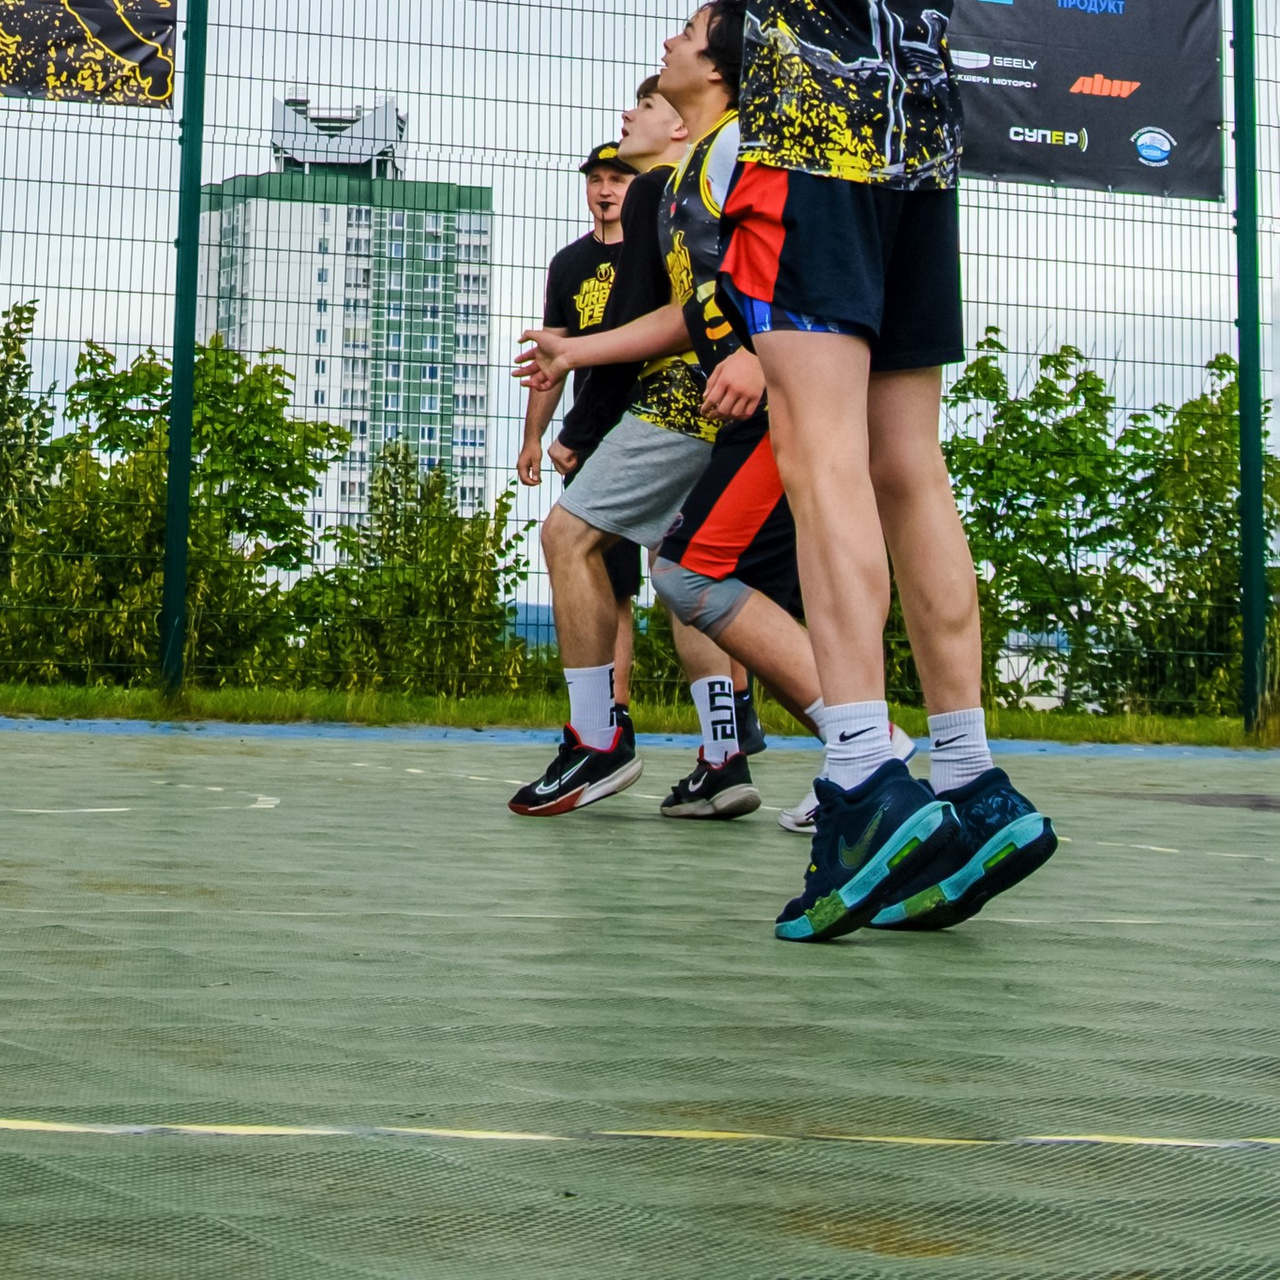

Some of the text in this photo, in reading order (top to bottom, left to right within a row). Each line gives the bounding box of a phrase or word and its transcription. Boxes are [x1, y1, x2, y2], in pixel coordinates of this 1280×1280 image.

[993, 56, 1037, 70] GEELY
[1009, 126, 1078, 146] СУПЕР
[582, 279, 611, 295] MIN
[578, 288, 611, 309] URB
